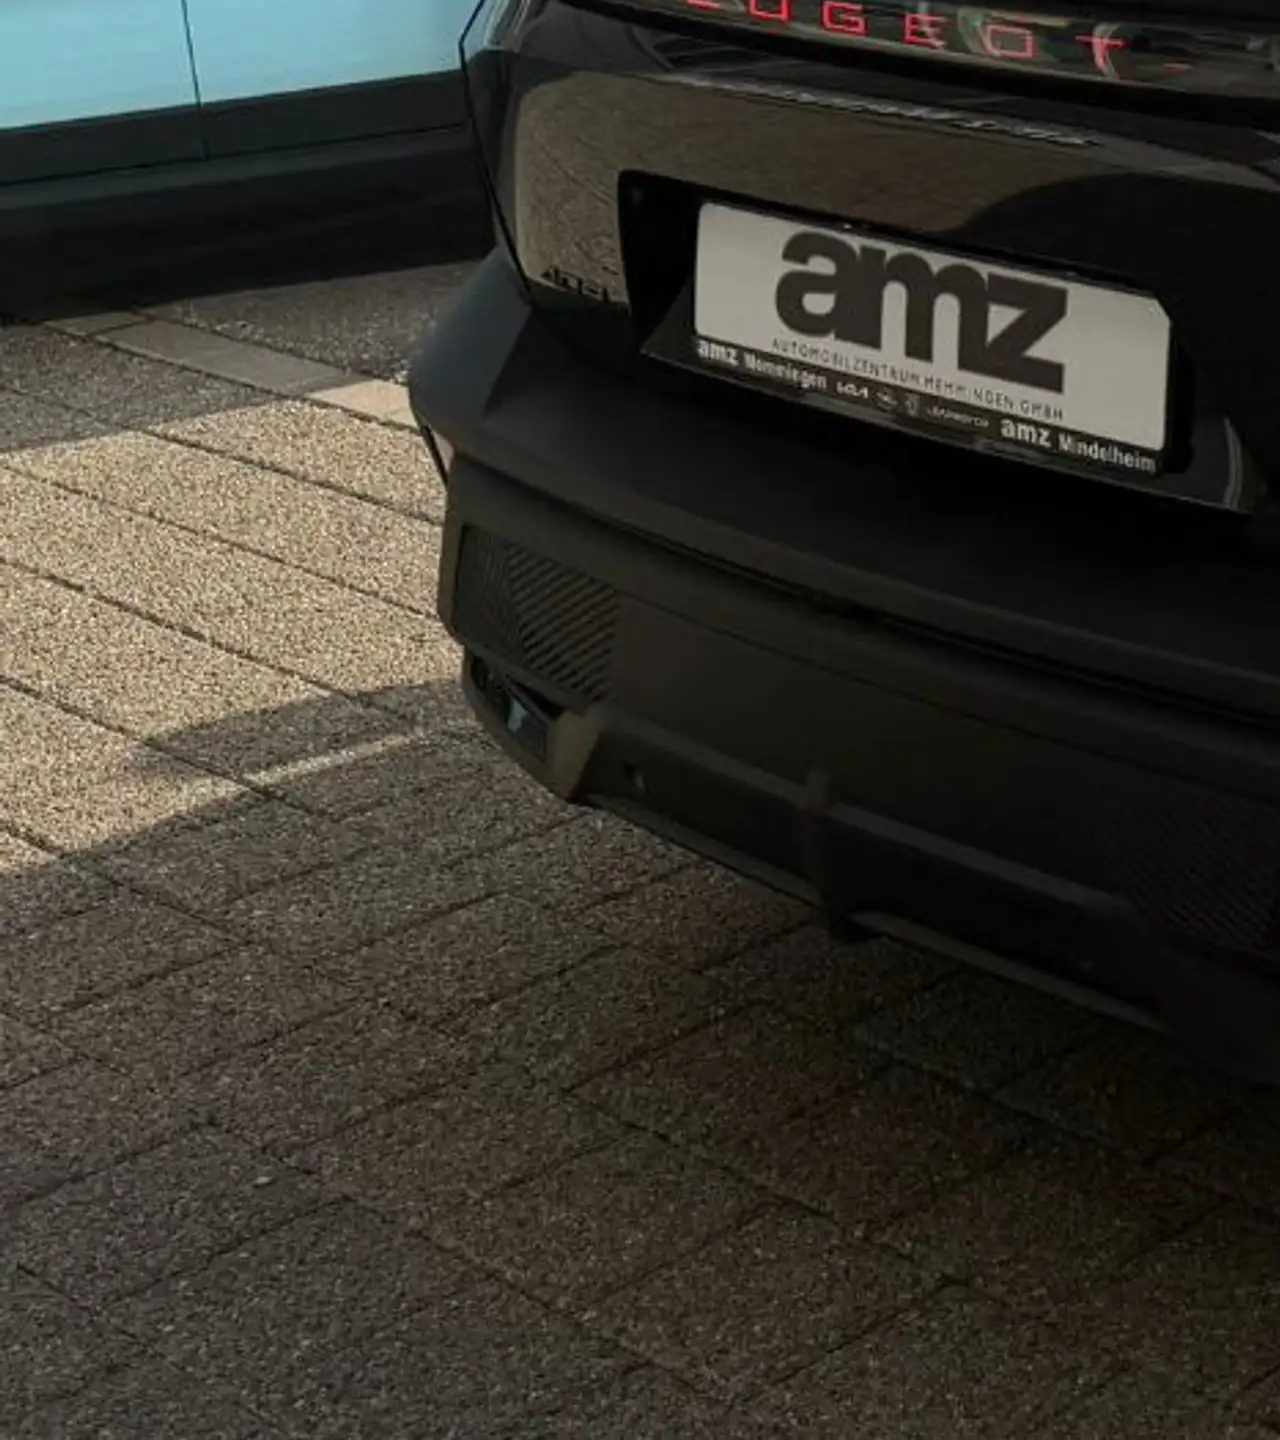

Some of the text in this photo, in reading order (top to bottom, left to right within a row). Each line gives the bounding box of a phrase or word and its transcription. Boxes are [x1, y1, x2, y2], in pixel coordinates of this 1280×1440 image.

[775, 231, 1068, 394] amz
[696, 339, 739, 367] amz
[1000, 417, 1052, 449] amz
[1058, 432, 1157, 474] Mindelheim
